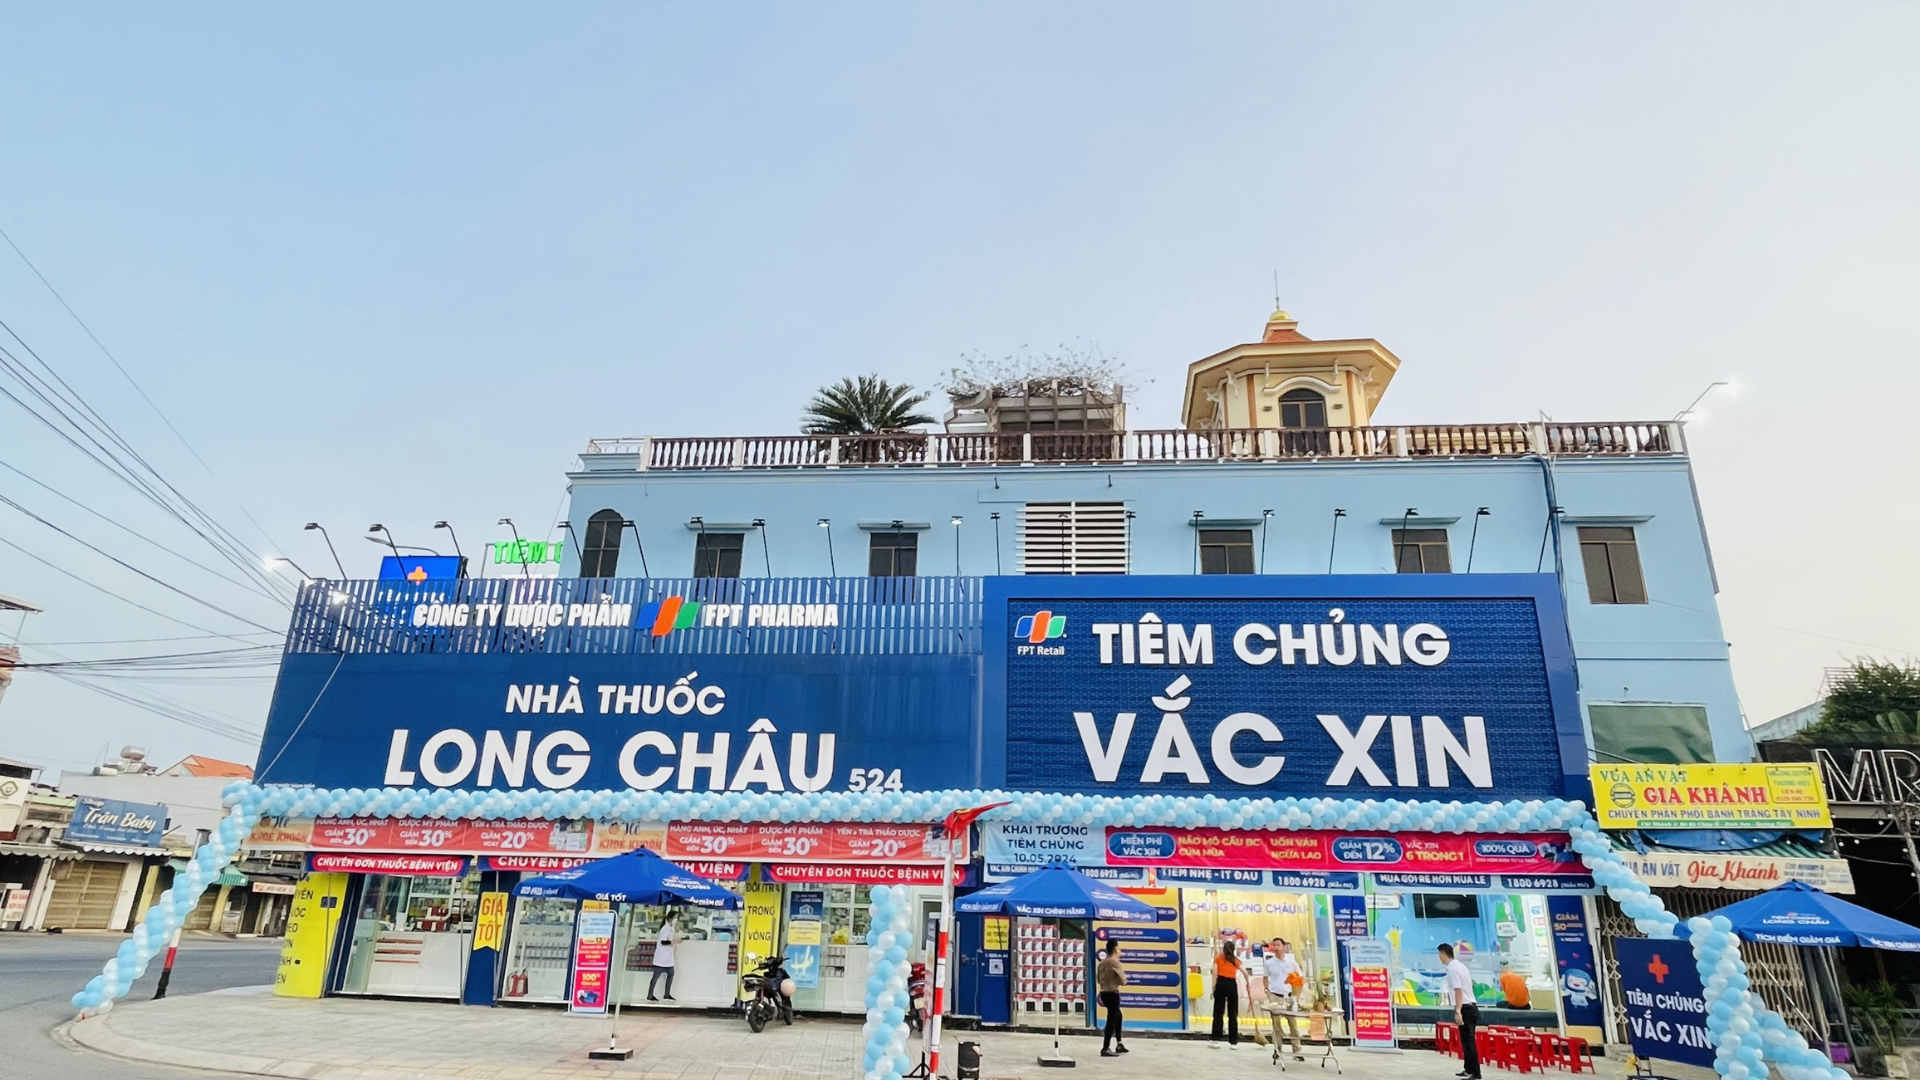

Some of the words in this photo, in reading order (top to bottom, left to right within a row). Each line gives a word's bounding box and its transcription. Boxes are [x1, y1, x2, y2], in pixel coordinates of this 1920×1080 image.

[412, 600, 469, 627] CÔNG
[566, 593, 632, 627] PHẨM
[705, 604, 742, 627] FPT
[748, 603, 839, 627] PHARMA
[1092, 613, 1214, 665] TIÊM
[1233, 607, 1451, 666] CHỦNG
[1017, 645, 1035, 656] FPT
[1037, 645, 1065, 656] Retail
[505, 676, 584, 714] NHÀ
[597, 671, 726, 715] THUỐC
[1073, 674, 1287, 786] VẮC
[1316, 714, 1495, 788] XIN
[384, 727, 591, 790] LONG
[618, 718, 837, 792] CHÂU
[849, 768, 904, 794] 524
[1643, 787, 1685, 804] GIA
[1686, 782, 1768, 804] KHÁNH
[1796, 809, 1821, 819] NINH
[120, 812, 157, 835] Baby
[1003, 825, 1033, 835] KHAI
[1036, 825, 1088, 836] TRƯƠNG
[500, 831, 535, 849] 20%
[699, 835, 736, 854] 30%
[782, 837, 819, 855] 30%
[1007, 837, 1036, 849] TIÊM
[1040, 836, 1084, 850] CHỦNG
[1120, 833, 1145, 845] MIỄN
[1146, 834, 1163, 845] PHÍ
[1424, 841, 1439, 850] XIN
[870, 839, 907, 857] 20%
[1144, 847, 1161, 857] XIN
[1301, 850, 1322, 860] LAO
[1363, 841, 1396, 861] 12%
[1406, 851, 1414, 861] 6
[1415, 850, 1457, 861] TRONG
[1481, 842, 1506, 853] 100%
[1506, 842, 1530, 854] QUÀ
[316, 856, 354, 867] CHUYÊN
[354, 858, 377, 868] ĐƠN
[377, 857, 409, 870] THUỐC
[409, 859, 434, 872] BỆNH
[435, 859, 459, 872] VIỆN
[1014, 852, 1077, 864] 10.05.2024
[698, 861, 735, 876] VIỆN
[776, 864, 824, 877] CHUYÊN
[826, 866, 853, 878] ĐƠN
[854, 865, 895, 879] THUỐC
[897, 866, 930, 881] BỆNH
[1081, 868, 1099, 878] 1800
[1100, 869, 1118, 879] 6928
[1234, 871, 1259, 881] ĐAU
[1278, 875, 1302, 887] 1800
[1302, 877, 1326, 888] 6928
[1507, 878, 1533, 888] 1800
[1534, 878, 1559, 888] 6928
[482, 896, 504, 917] GIÁ
[1016, 904, 1032, 914] VẮC
[1032, 906, 1044, 915] XIN
[1231, 903, 1262, 913] LONG
[478, 920, 502, 942] TỐT
[1755, 933, 1777, 941] TÍCH
[1825, 935, 1841, 944] GIÁ
[1626, 987, 1654, 1008] TIÊM
[1656, 991, 1704, 1013] CHỦNG
[1630, 1009, 1672, 1042] VẮC
[1675, 1023, 1713, 1049] XIN
